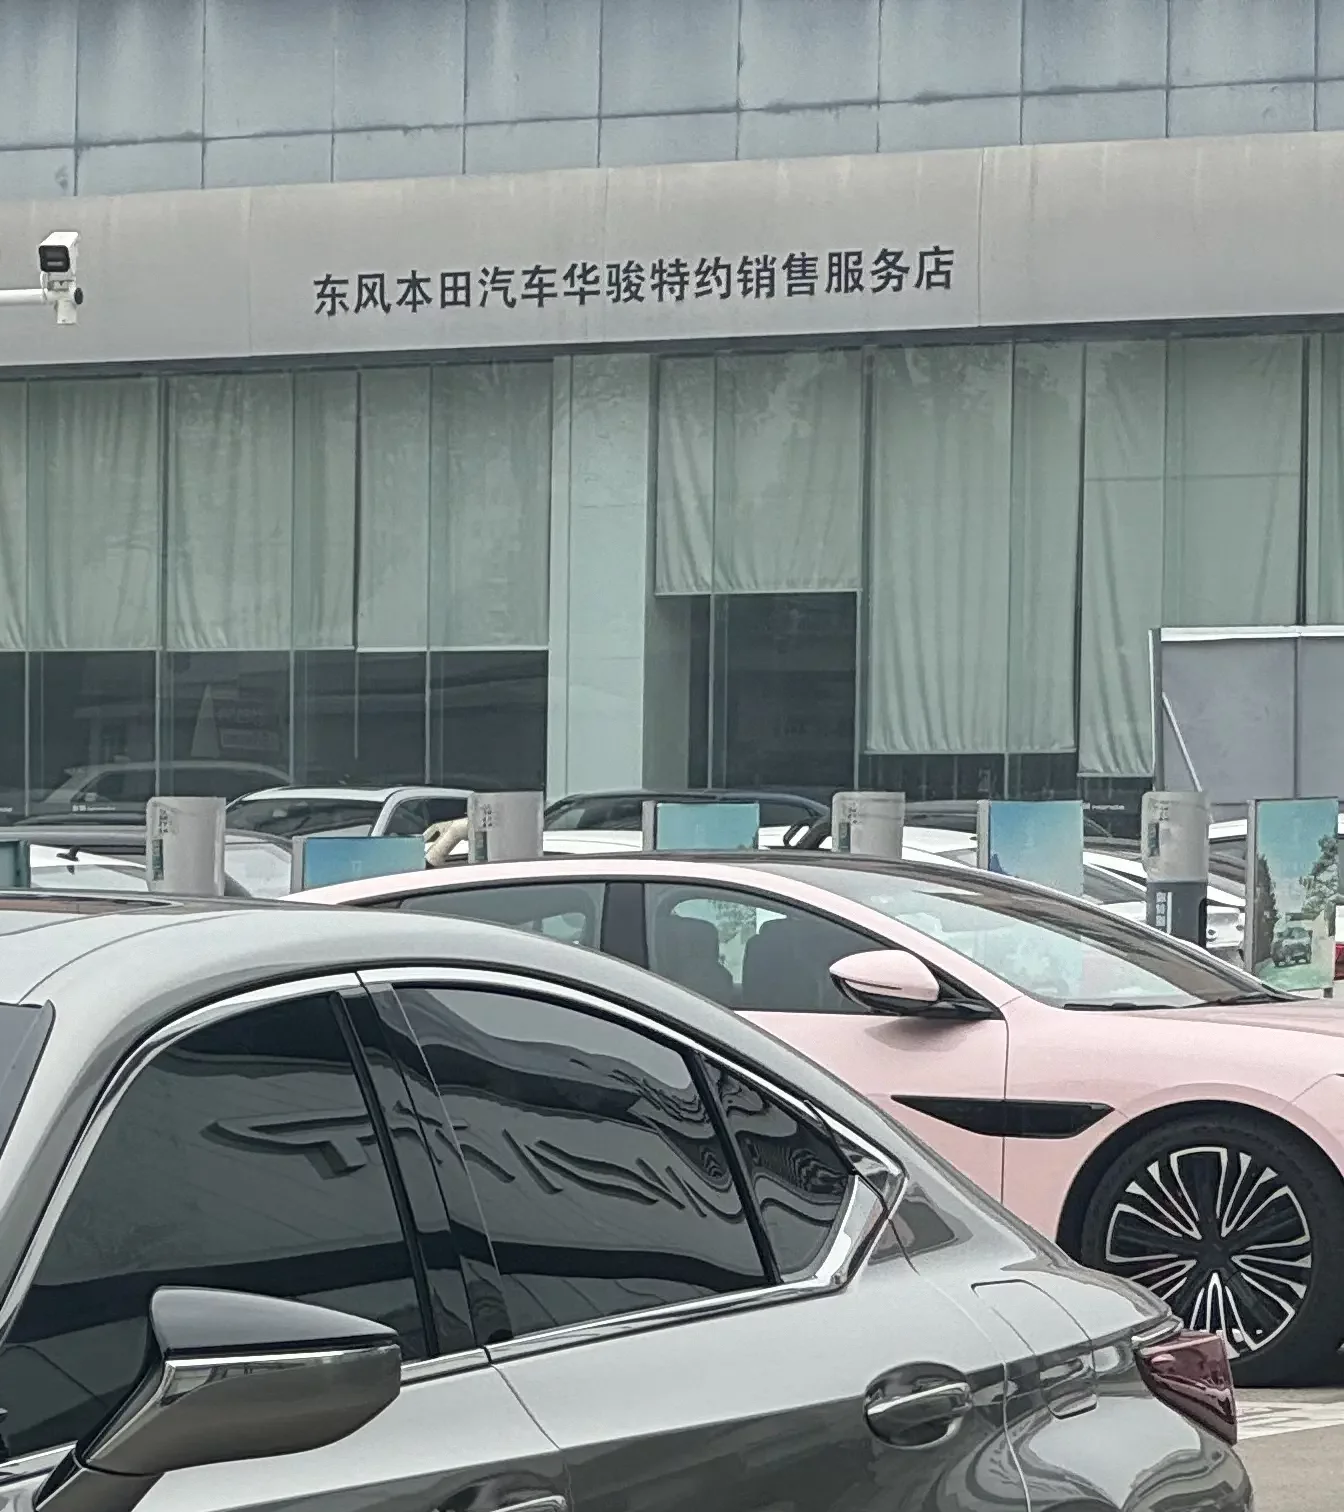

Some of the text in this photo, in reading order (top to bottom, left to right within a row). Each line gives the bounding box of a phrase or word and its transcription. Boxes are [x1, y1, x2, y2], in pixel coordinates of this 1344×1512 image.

[313, 245, 956, 318] 东风本田汽车华骏特约销售服务店
